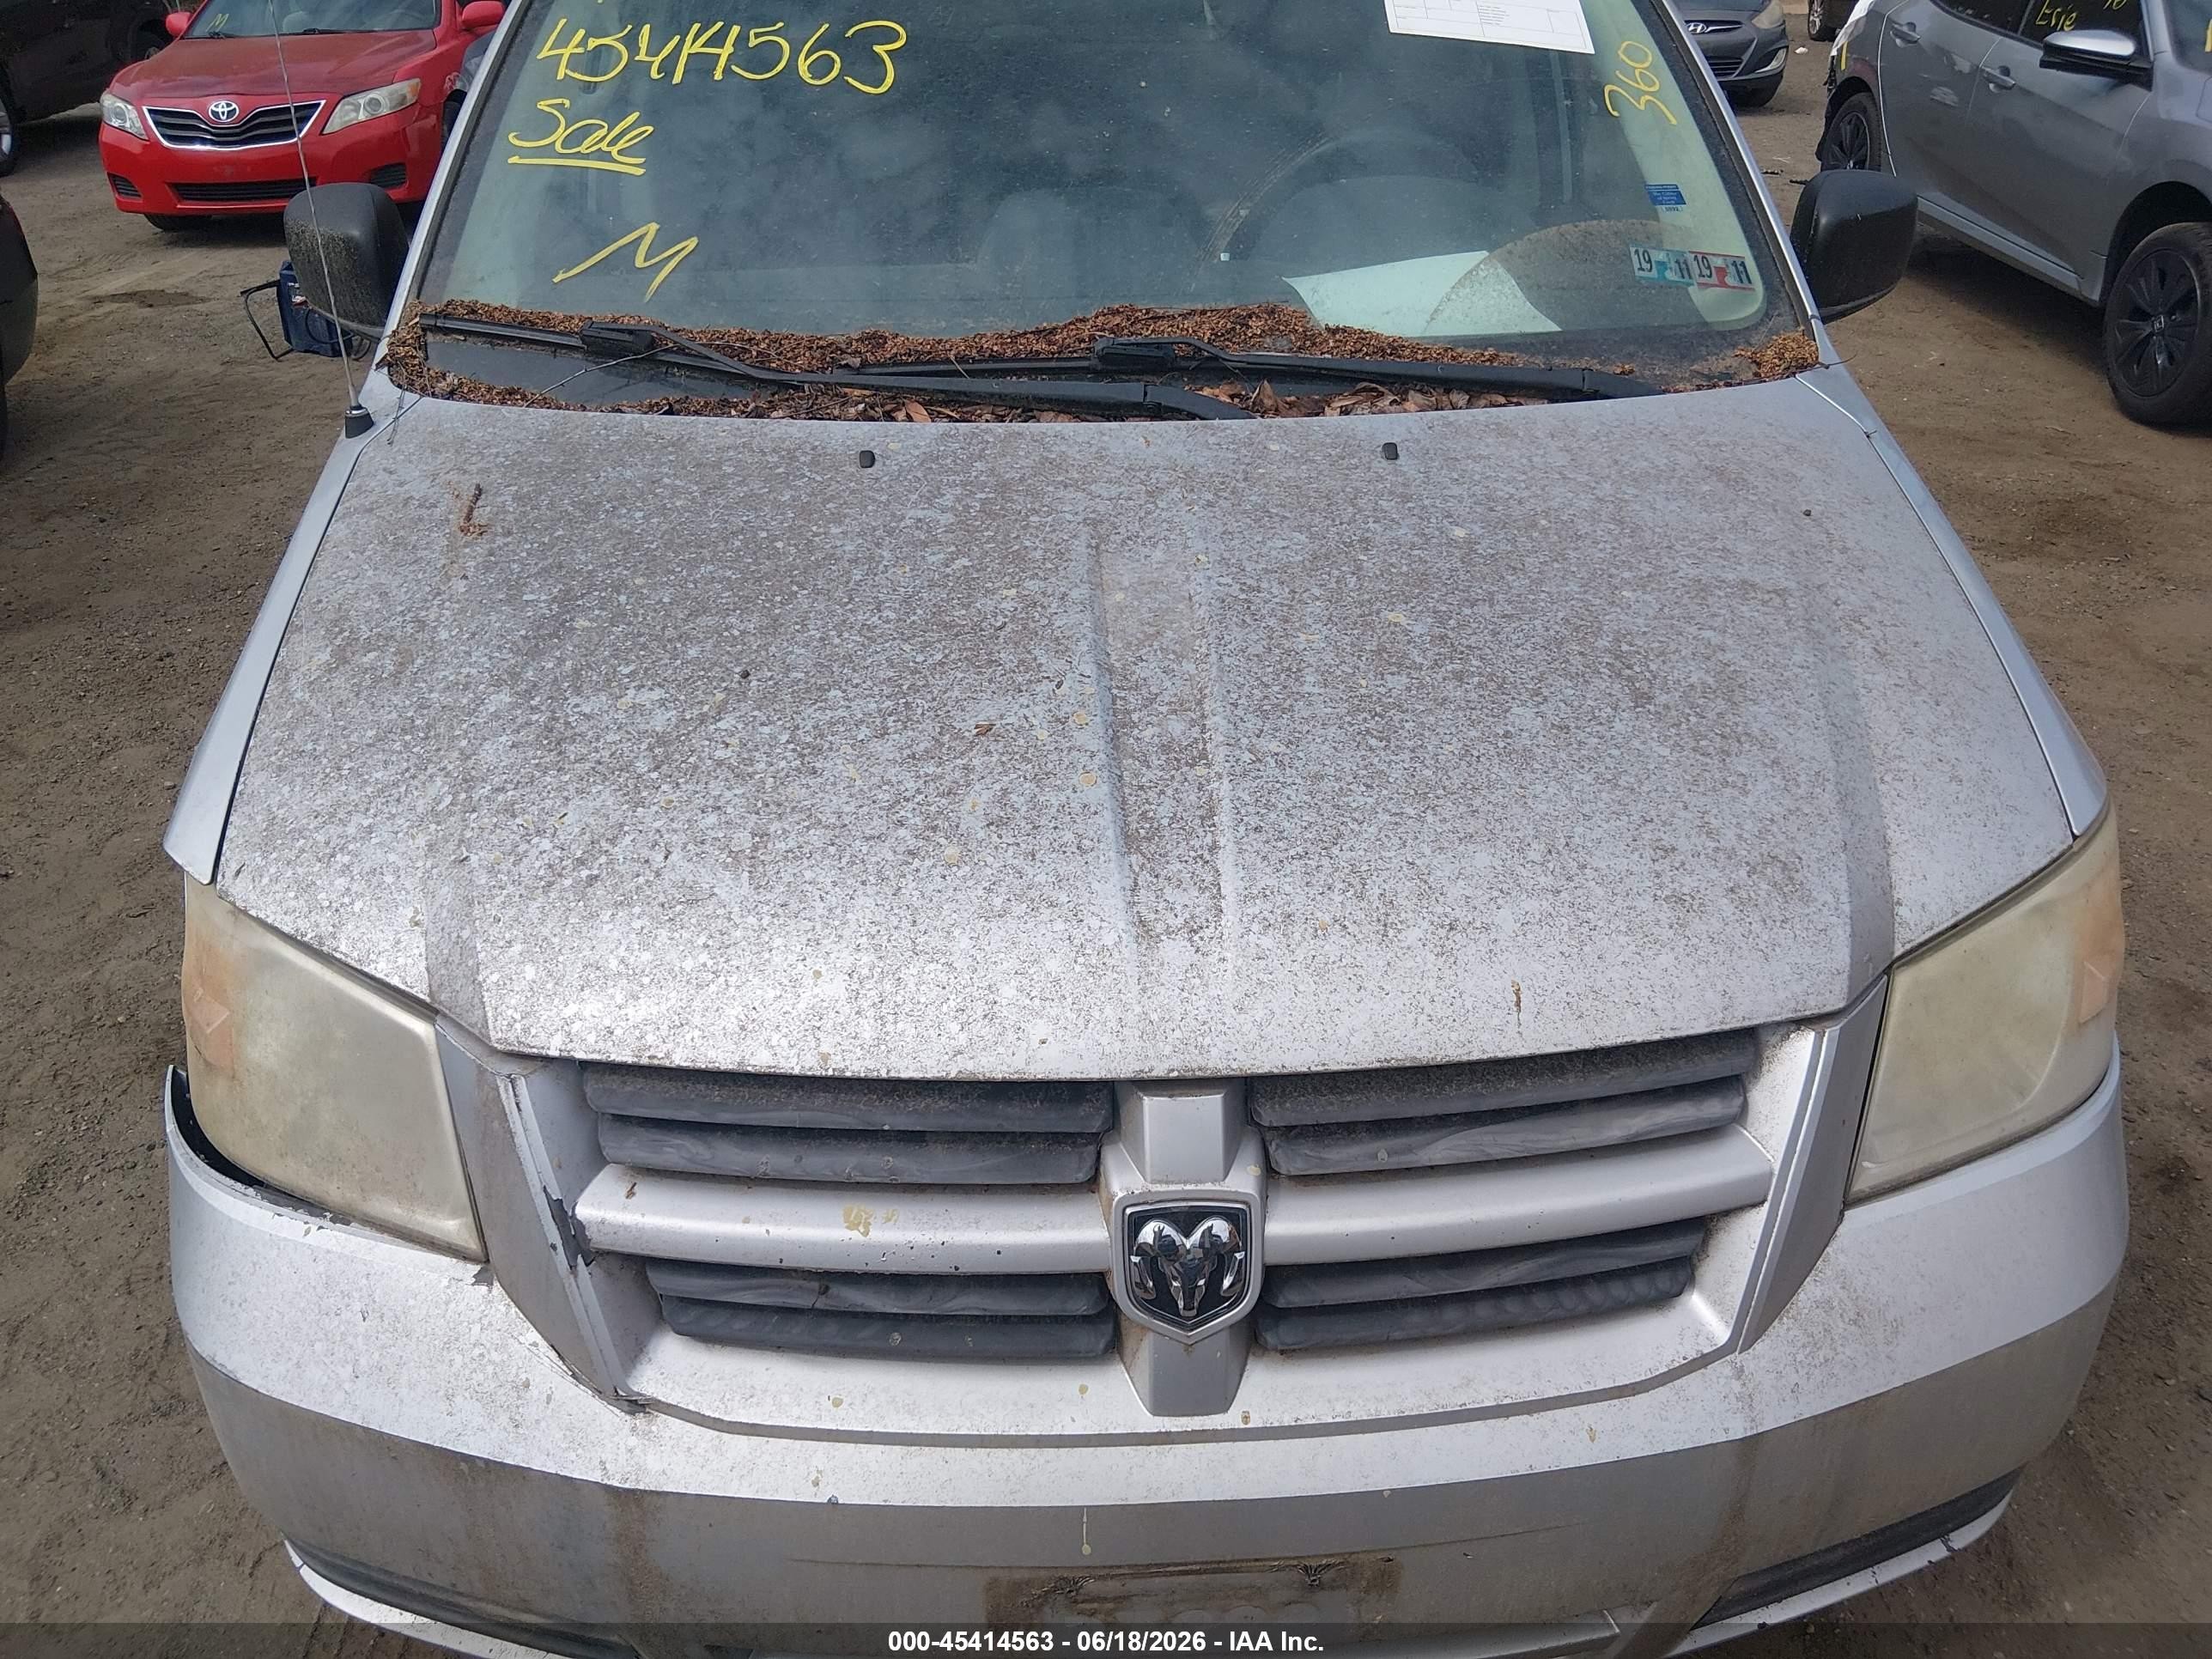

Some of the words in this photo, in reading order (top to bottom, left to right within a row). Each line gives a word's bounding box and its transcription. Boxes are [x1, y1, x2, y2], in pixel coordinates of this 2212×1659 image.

[537, 18, 907, 94] 45414563
[1604, 40, 1678, 125] 360
[508, 98, 654, 165] Sale
[1634, 248, 1653, 272] 19
[1675, 258, 1693, 280] 11
[1693, 254, 1713, 278] 19
[1730, 260, 1753, 284] 11
